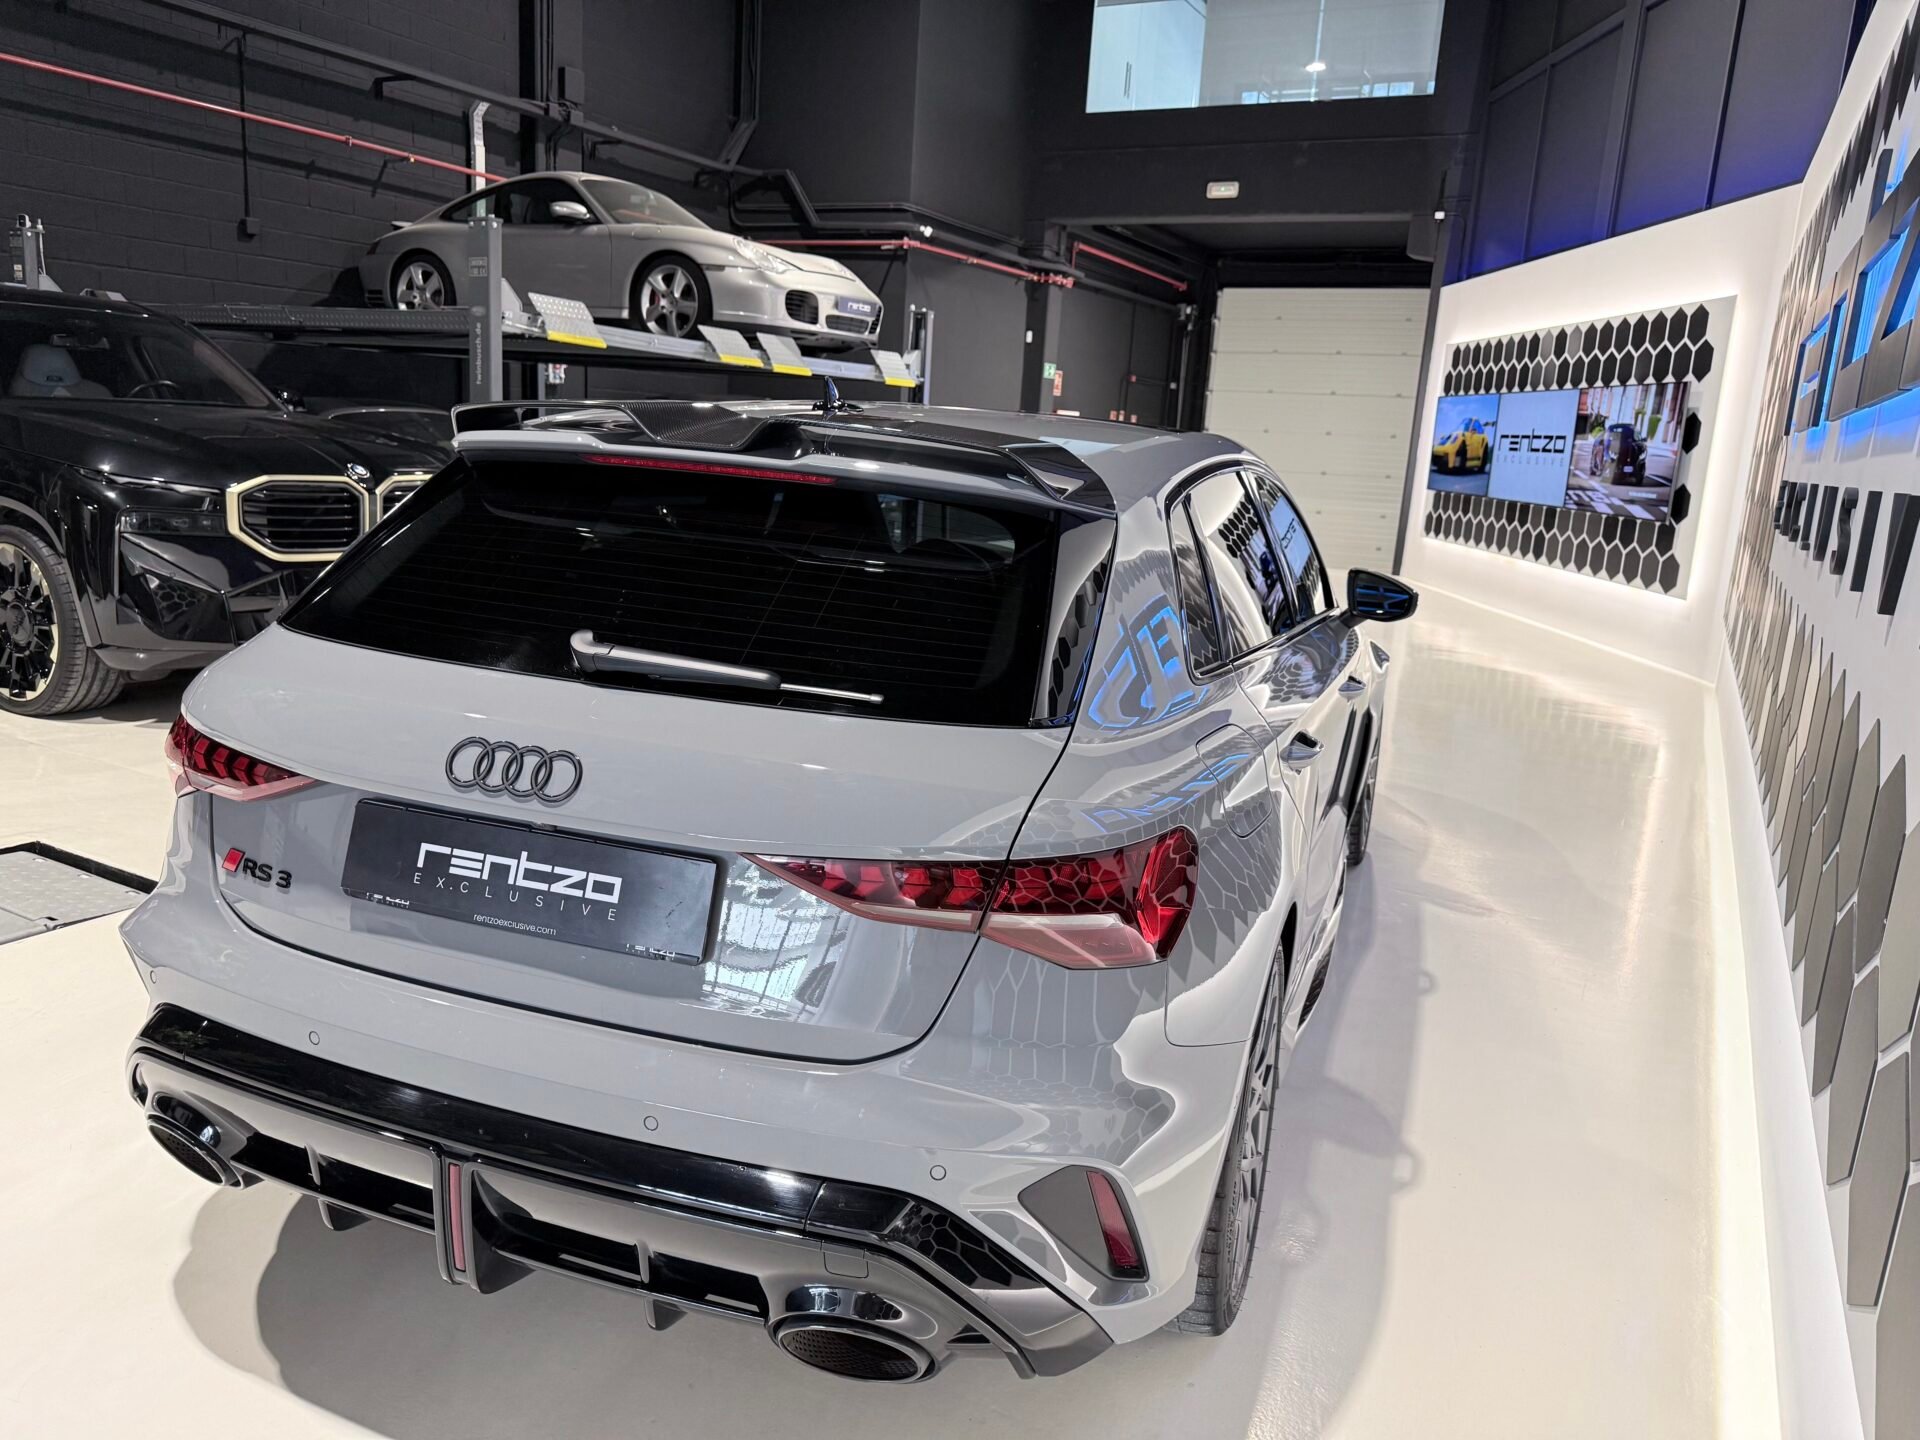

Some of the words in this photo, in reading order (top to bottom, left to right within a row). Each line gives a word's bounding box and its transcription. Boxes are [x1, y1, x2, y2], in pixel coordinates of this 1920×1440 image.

[1498, 428, 1566, 453] rentzo
[1774, 480, 1920, 617] EXCLUSIV
[243, 857, 273, 882] RS
[276, 870, 293, 888] 3
[417, 842, 622, 904] rentzo
[473, 914, 558, 936] rentzoexclusive.com
